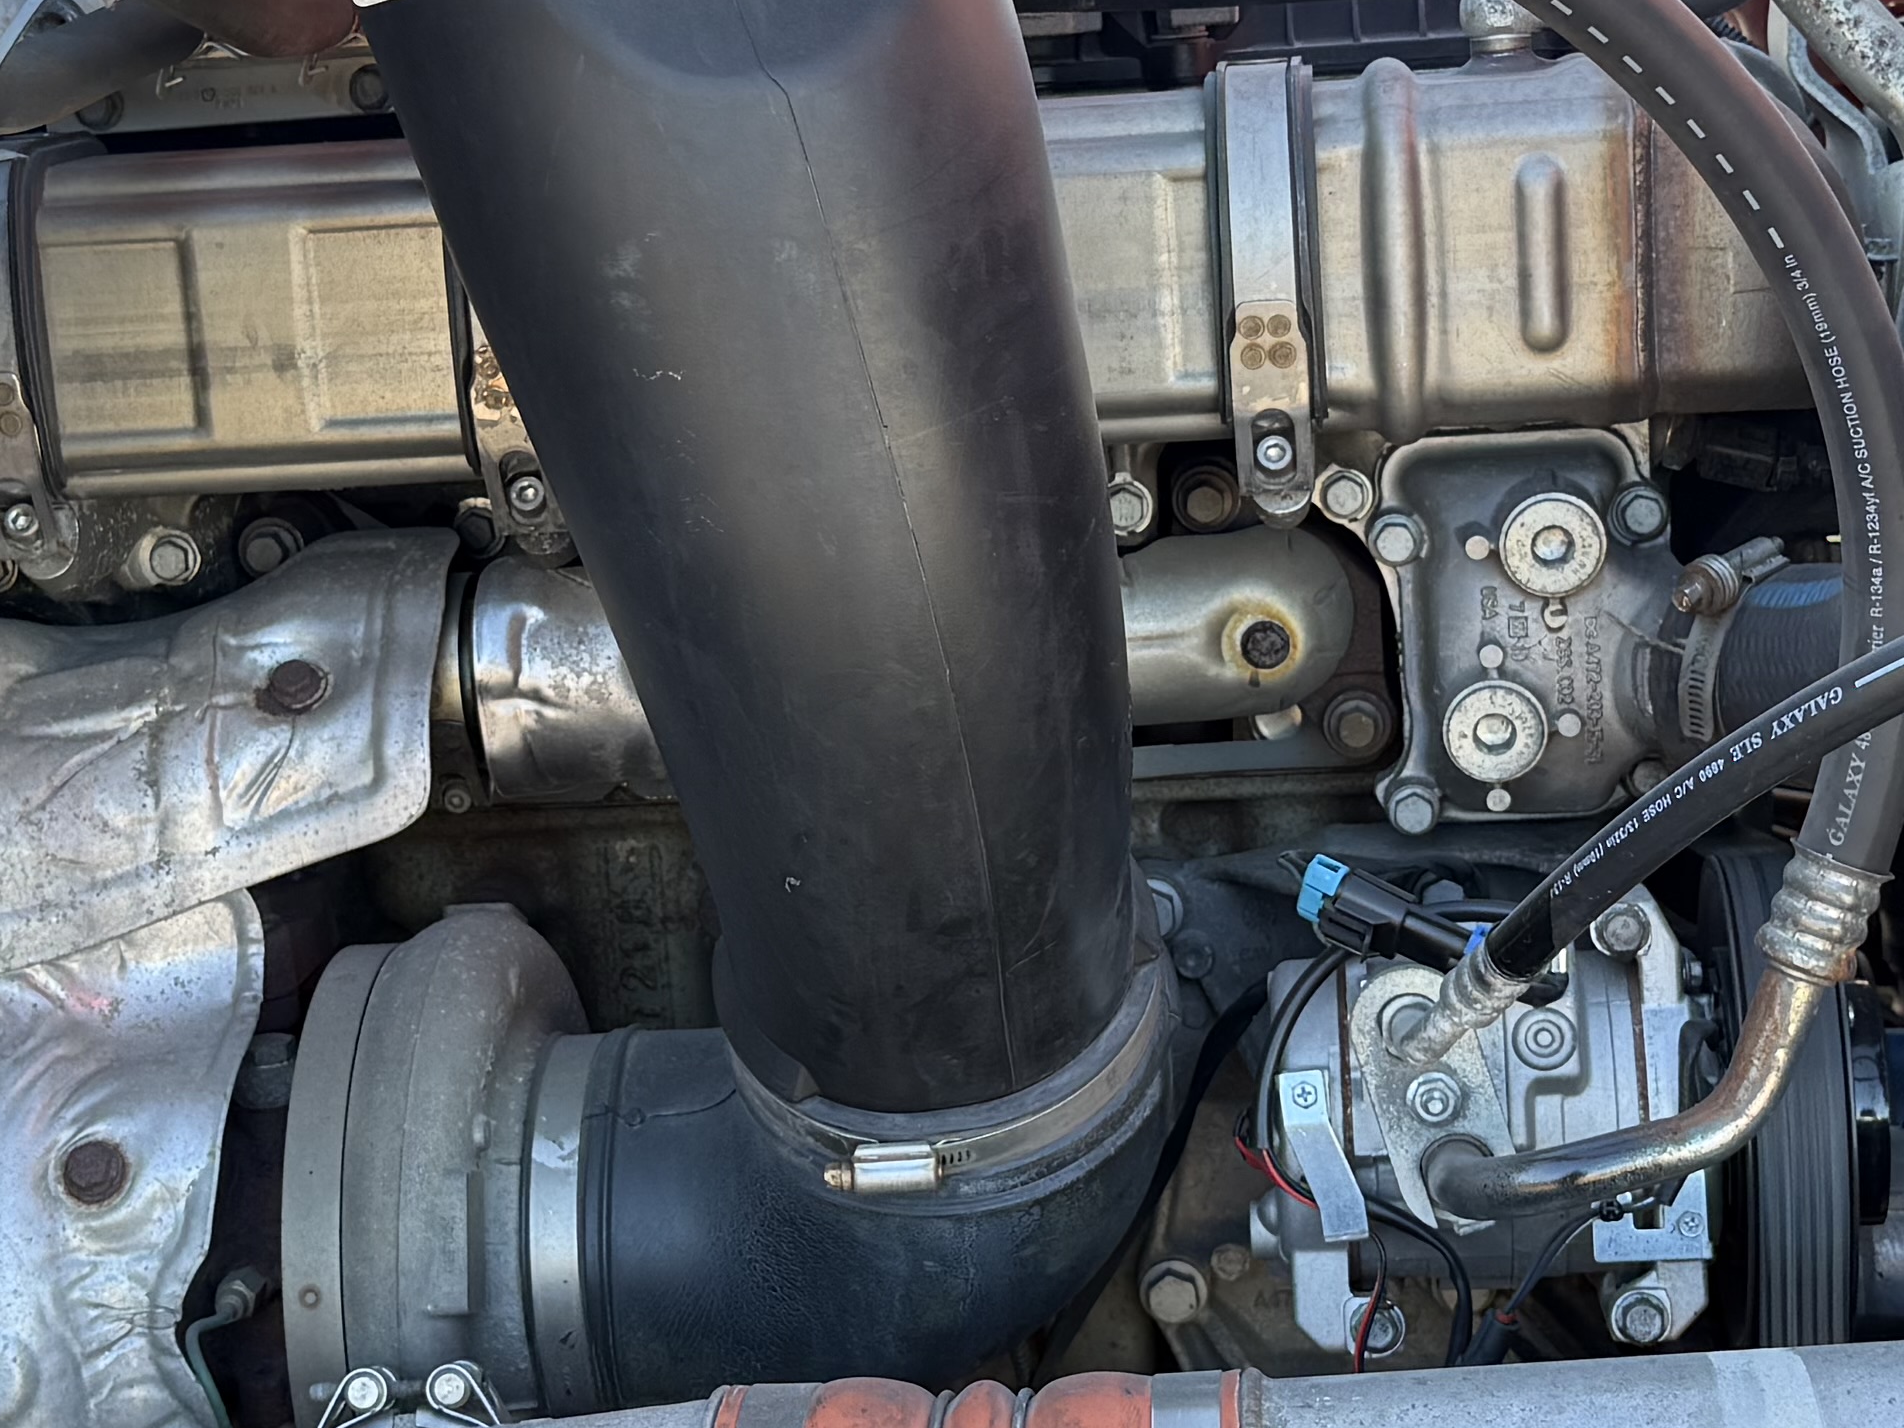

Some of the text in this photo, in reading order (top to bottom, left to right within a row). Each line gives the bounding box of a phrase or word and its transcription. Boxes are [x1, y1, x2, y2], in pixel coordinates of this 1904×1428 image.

[1790, 269, 1809, 291] 3/4
[1802, 292, 1836, 343] (19mm)
[1824, 346, 1849, 388] HOSE
[1840, 392, 1869, 459] SUCTION
[1857, 462, 1874, 489] A/C
[1862, 492, 1882, 555] R-1234yf
[1480, 586, 1498, 620] USA
[1868, 566, 1884, 618] R-134a
[1770, 685, 1844, 739] GALAXY
[1730, 731, 1764, 762] SLE
[1674, 776, 1695, 799] A/C
[1698, 757, 1726, 783] 4890
[1642, 795, 1672, 822] HOSE
[1829, 753, 1867, 846] GALAXY
